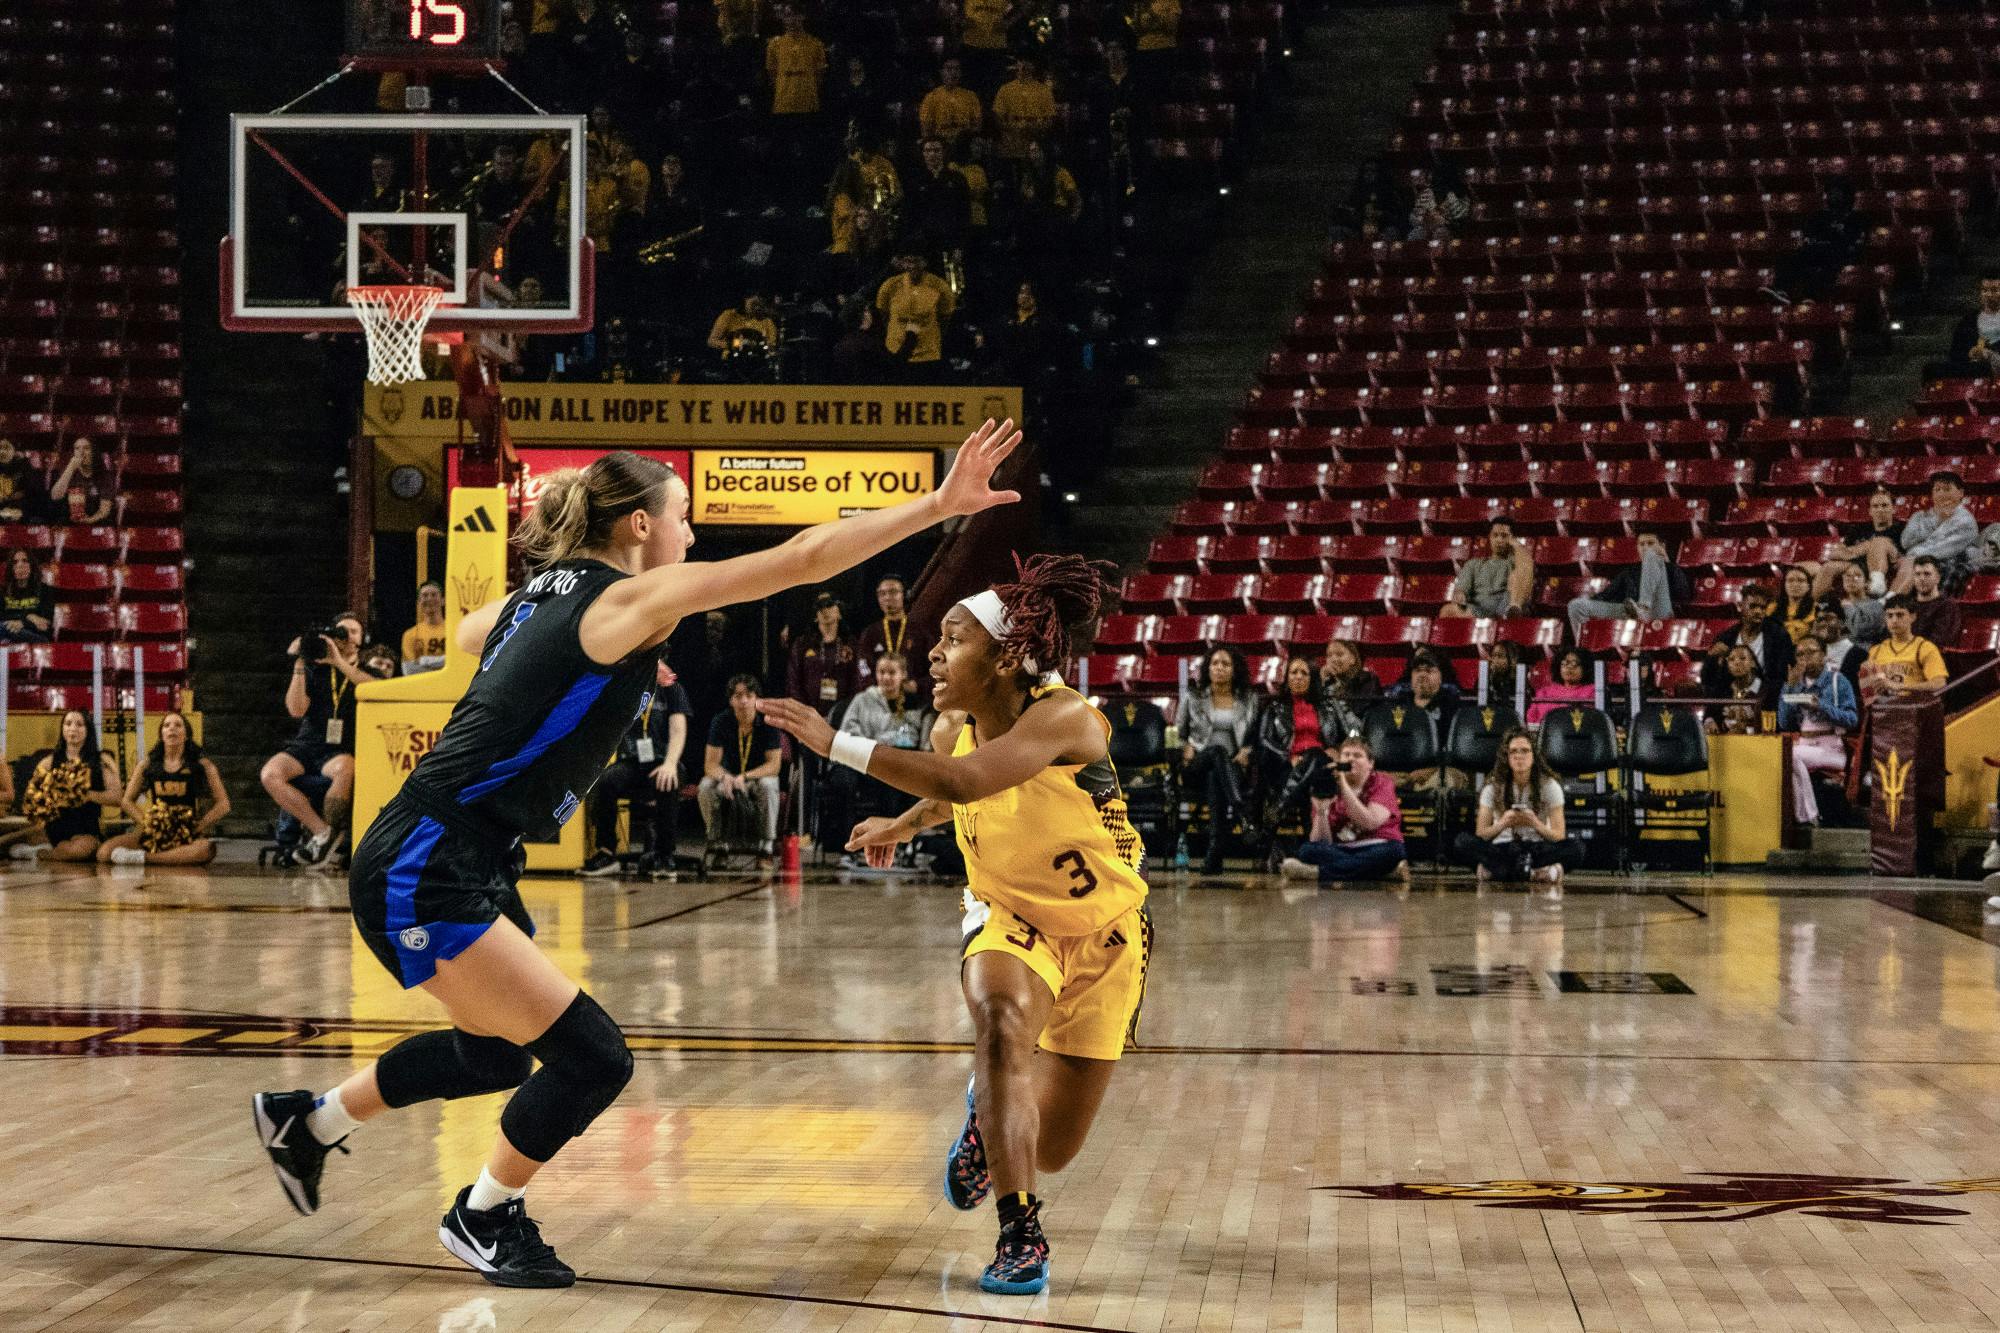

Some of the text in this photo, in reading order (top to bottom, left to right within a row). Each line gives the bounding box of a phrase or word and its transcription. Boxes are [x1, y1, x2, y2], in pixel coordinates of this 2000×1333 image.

[410, 0, 466, 44] 15
[421, 395, 965, 425] ABON ALL HOPE YE WHO ENTER HERE
[705, 470, 926, 493] because of YOU.
[409, 730, 443, 752] SU
[1052, 849, 1098, 898] 3
[1005, 912, 1039, 952] 3
